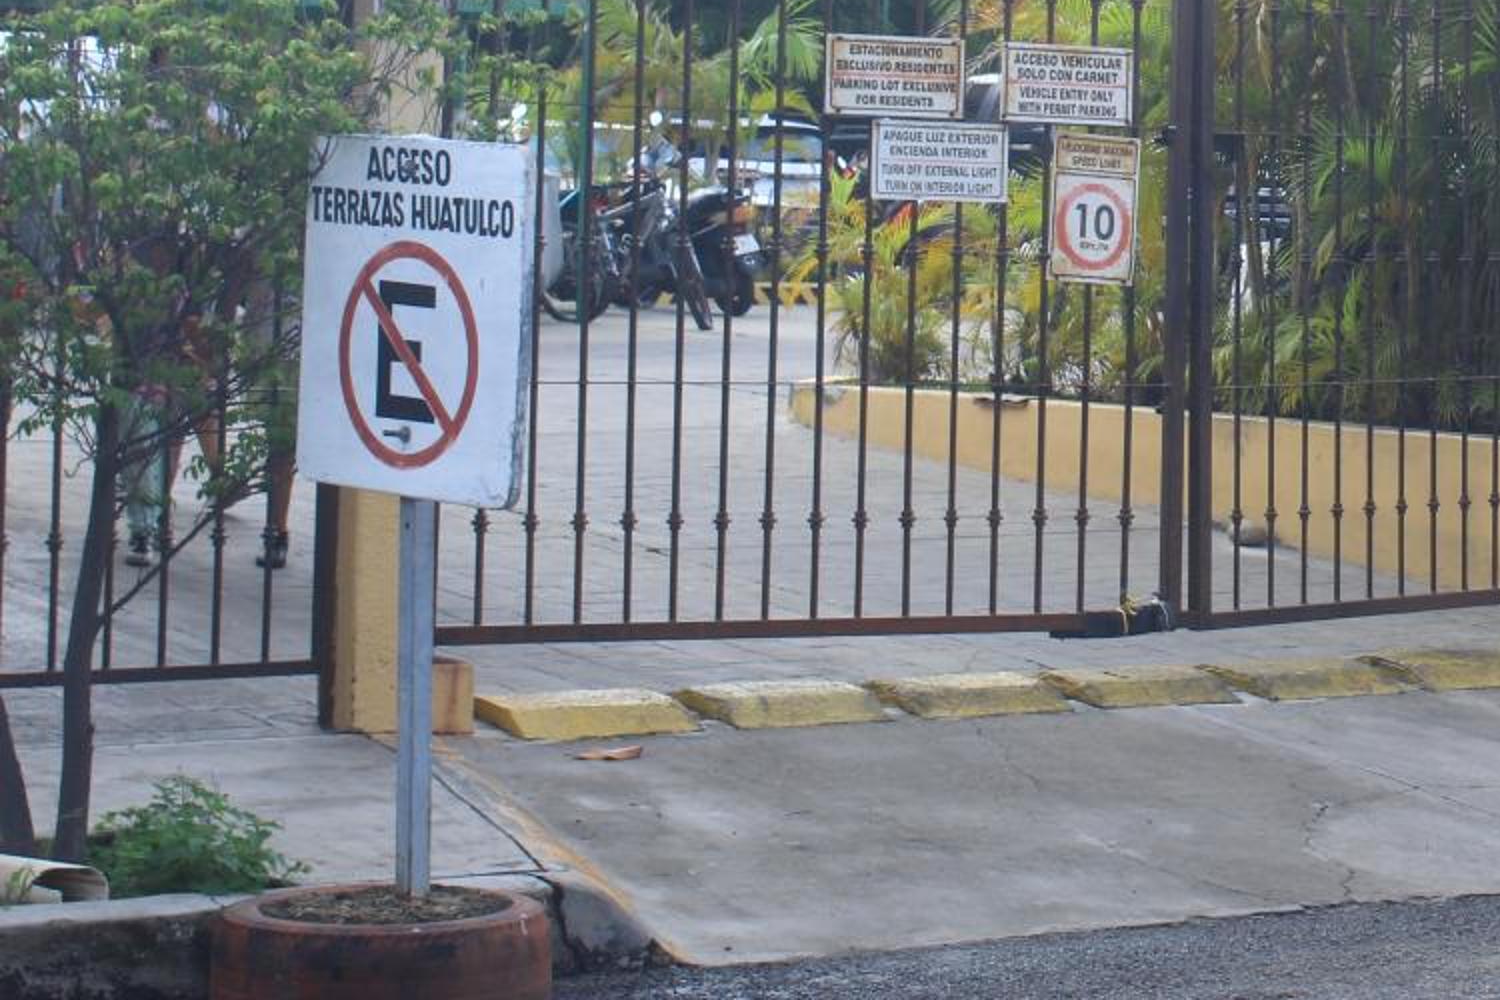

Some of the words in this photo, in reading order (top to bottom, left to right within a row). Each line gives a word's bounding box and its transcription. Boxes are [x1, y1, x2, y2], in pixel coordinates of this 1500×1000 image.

[849, 43, 943, 59] ESTACIONAMIENTO
[836, 59, 892, 72] EXCLUSIVO
[894, 61, 955, 74] RESIDENTES
[1014, 53, 1059, 67] ACCESO
[1061, 55, 1122, 70] VEHICULAR
[1017, 67, 1047, 81] SOLO
[1049, 69, 1073, 82] CON
[1075, 71, 1119, 85] CARNET
[833, 79, 879, 91] PARKING
[881, 81, 899, 92] LOT
[903, 82, 957, 93] EXCLUSIVE
[855, 94, 876, 105] FOR
[878, 95, 935, 107] RESIDENTS
[1019, 87, 1057, 100] VEHICLE
[1059, 88, 1089, 101] ENTRY
[1090, 90, 1113, 103] ONLY
[1017, 102, 1041, 113] WITH
[1043, 103, 1077, 115] PERMIT
[1078, 105, 1117, 118] PARKING
[883, 130, 923, 142] APAGUE
[926, 132, 944, 143] LUZ
[947, 132, 999, 145] EXTERIOR
[889, 145, 939, 157] ENCIENDA
[941, 147, 988, 159] INTERIOR
[367, 146, 451, 187] ACCESO
[881, 163, 905, 175] TURN
[906, 164, 922, 175] OFF
[925, 165, 969, 178] EXTERNAL
[971, 167, 997, 178] LIGHT
[884, 180, 909, 191] TURN
[910, 181, 923, 191] ON
[926, 181, 965, 193] INTERIOR
[967, 183, 994, 194] LIGHT
[311, 186, 405, 228] TERRAZAS
[411, 194, 515, 239] HUATULCO
[1075, 203, 1115, 241] 10
